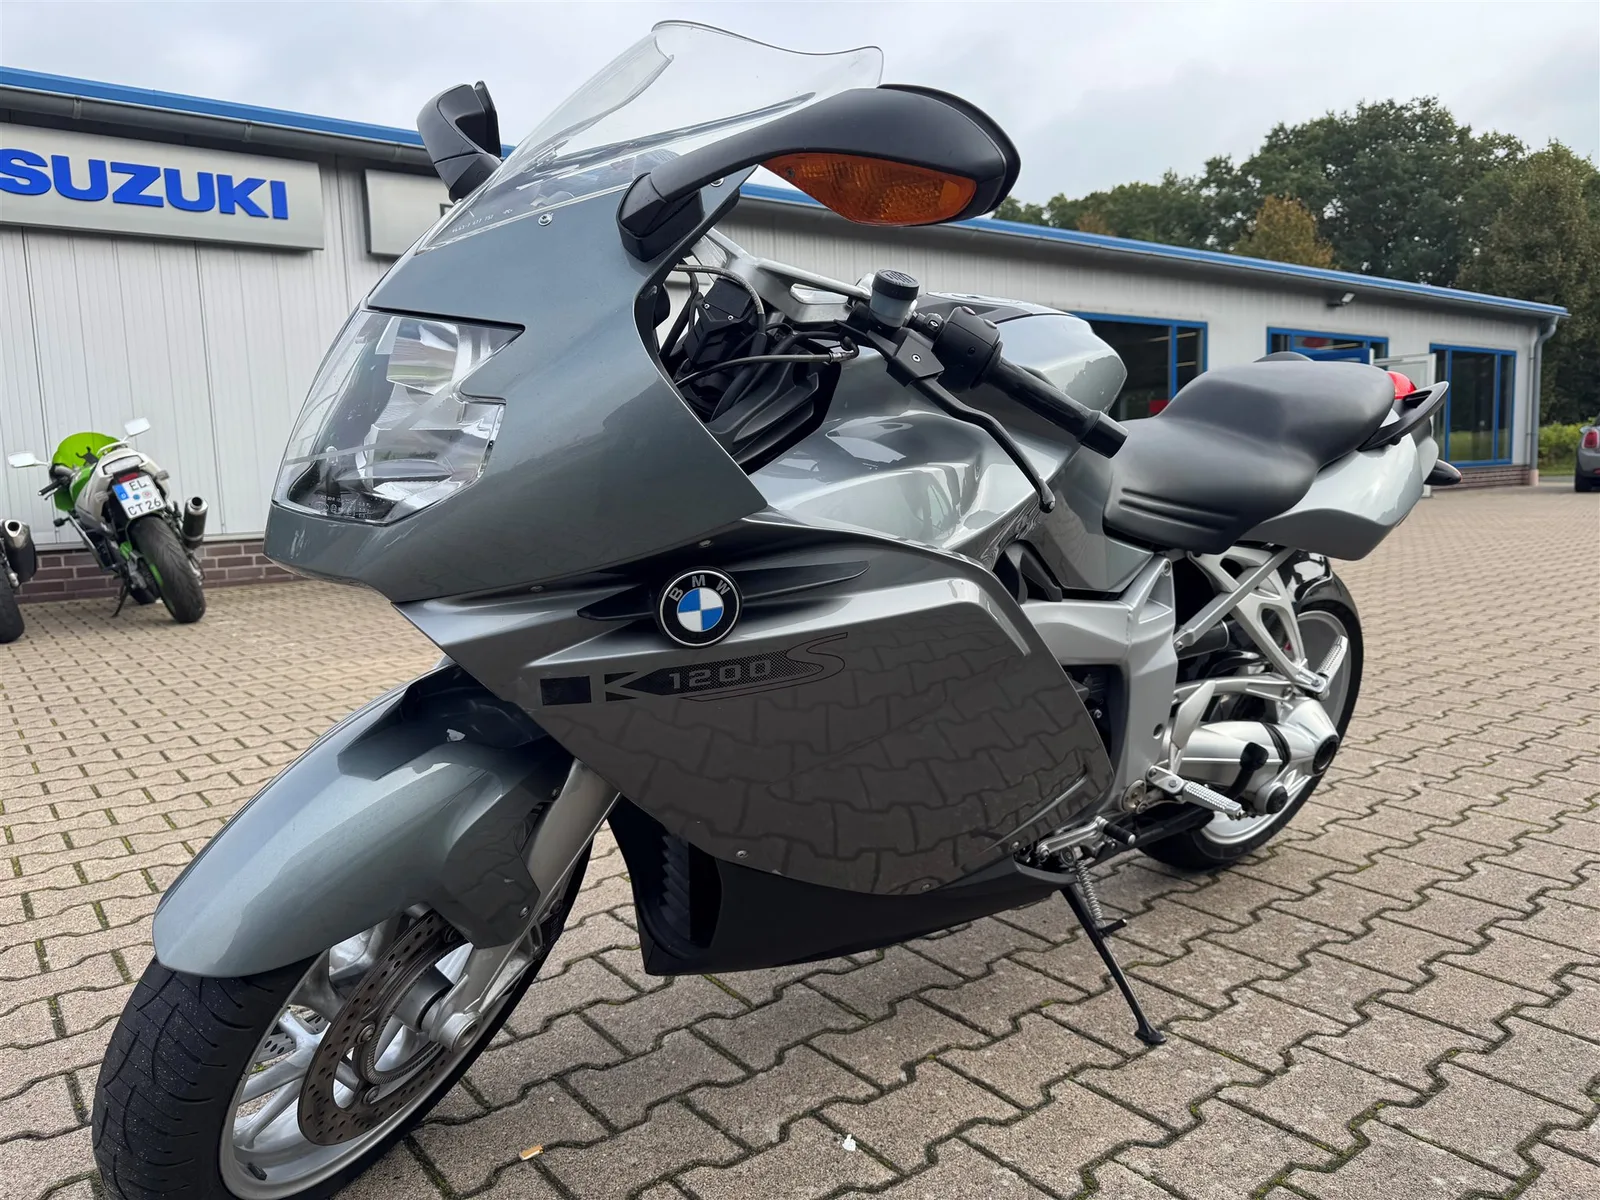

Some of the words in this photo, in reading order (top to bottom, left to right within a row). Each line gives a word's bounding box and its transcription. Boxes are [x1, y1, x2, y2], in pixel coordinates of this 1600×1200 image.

[0, 148, 289, 220] SUZUKI
[129, 480, 148, 491] EL
[668, 574, 731, 602] BMW
[668, 659, 772, 690] 1200
